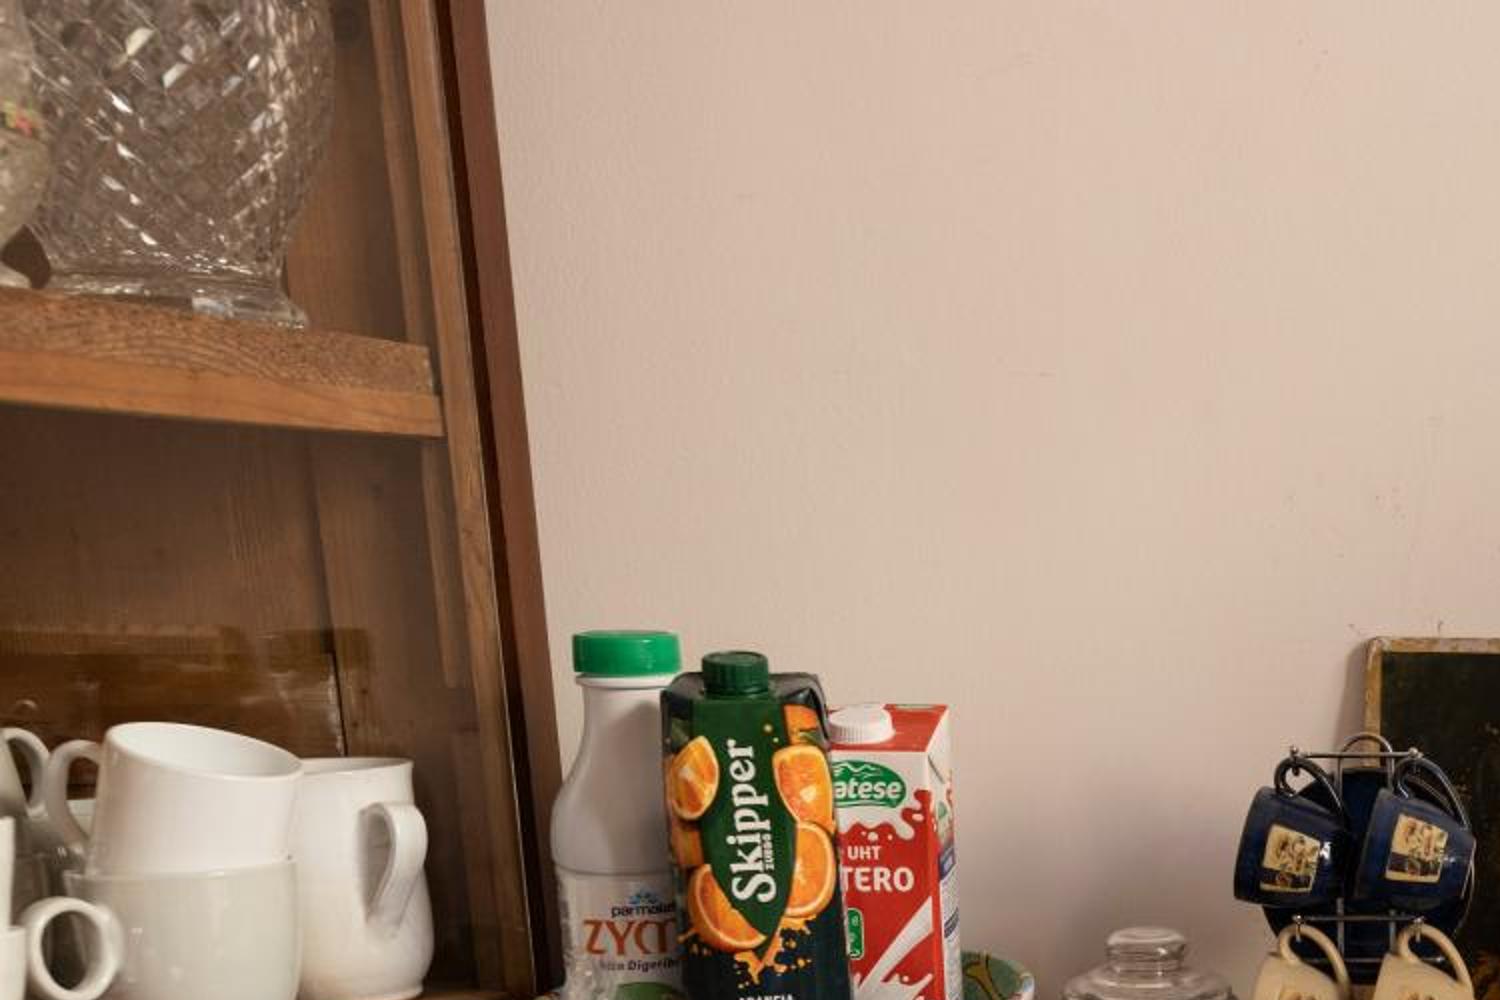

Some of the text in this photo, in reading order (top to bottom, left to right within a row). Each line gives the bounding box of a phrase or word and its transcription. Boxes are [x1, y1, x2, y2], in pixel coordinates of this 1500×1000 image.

[833, 777, 903, 801] atese
[727, 738, 777, 903] Skipper
[846, 845, 883, 861] UHT
